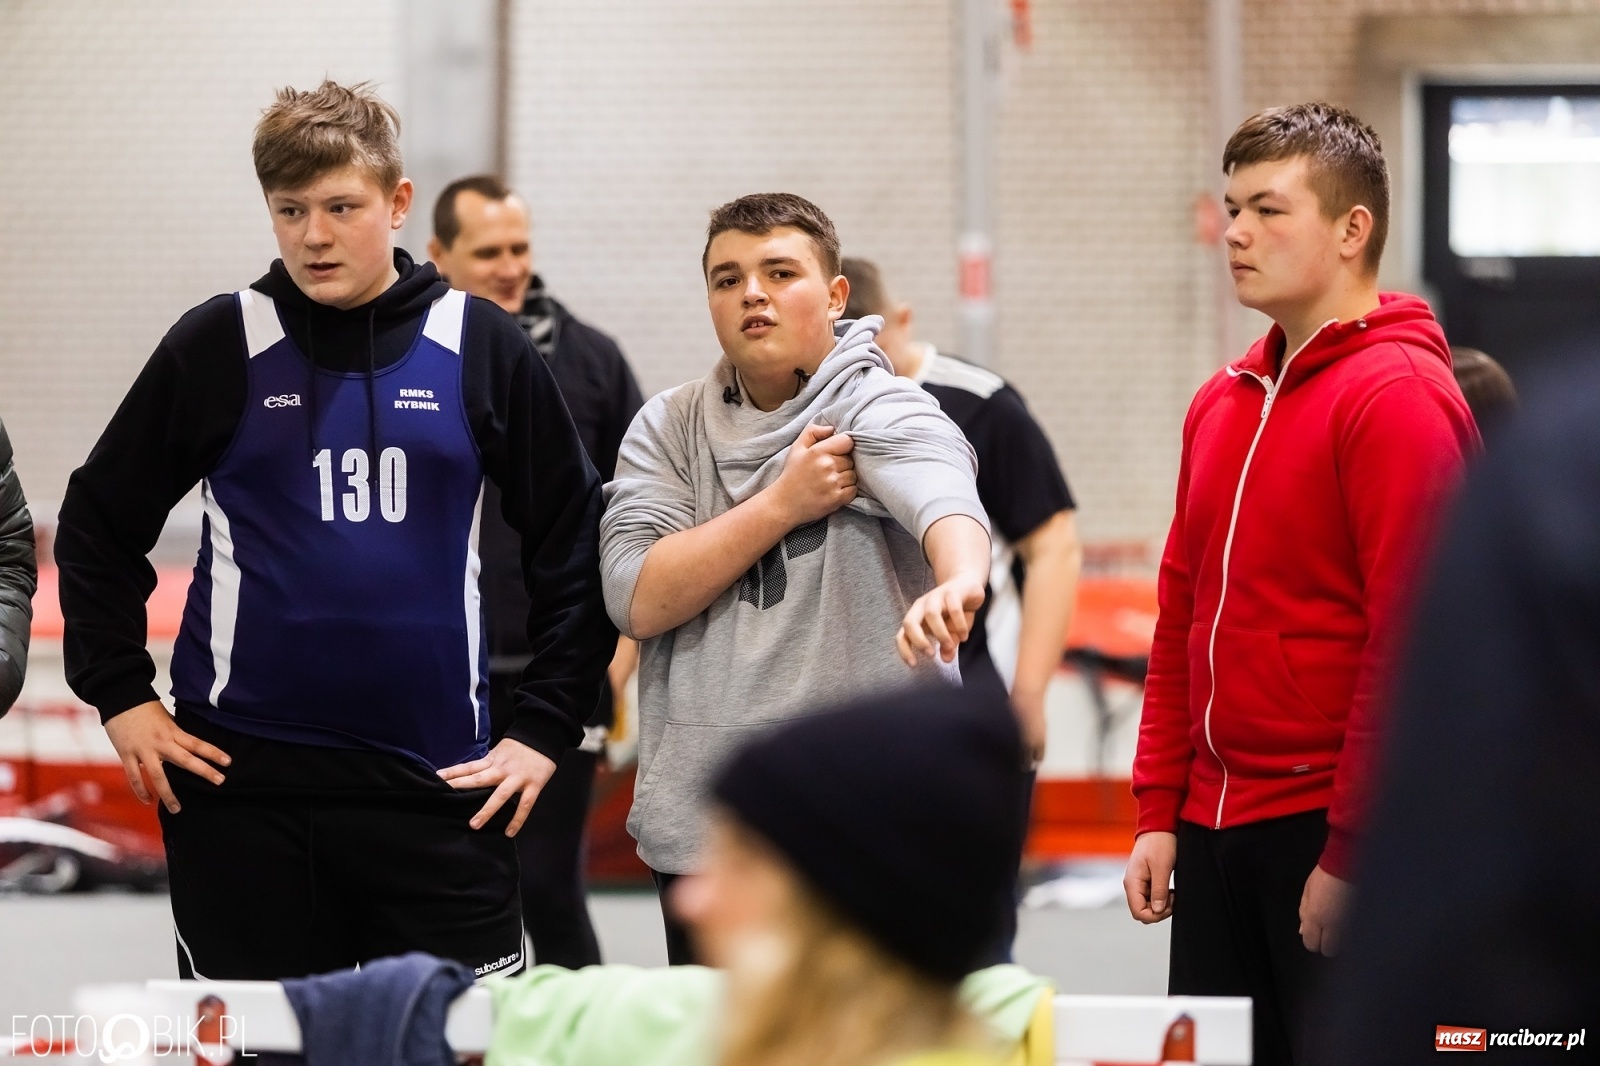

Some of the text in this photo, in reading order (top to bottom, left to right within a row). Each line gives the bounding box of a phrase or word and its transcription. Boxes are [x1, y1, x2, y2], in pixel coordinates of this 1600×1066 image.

[400, 389, 434, 399] RMKS
[394, 400, 440, 411] RYBNIK
[312, 446, 407, 523] 130
